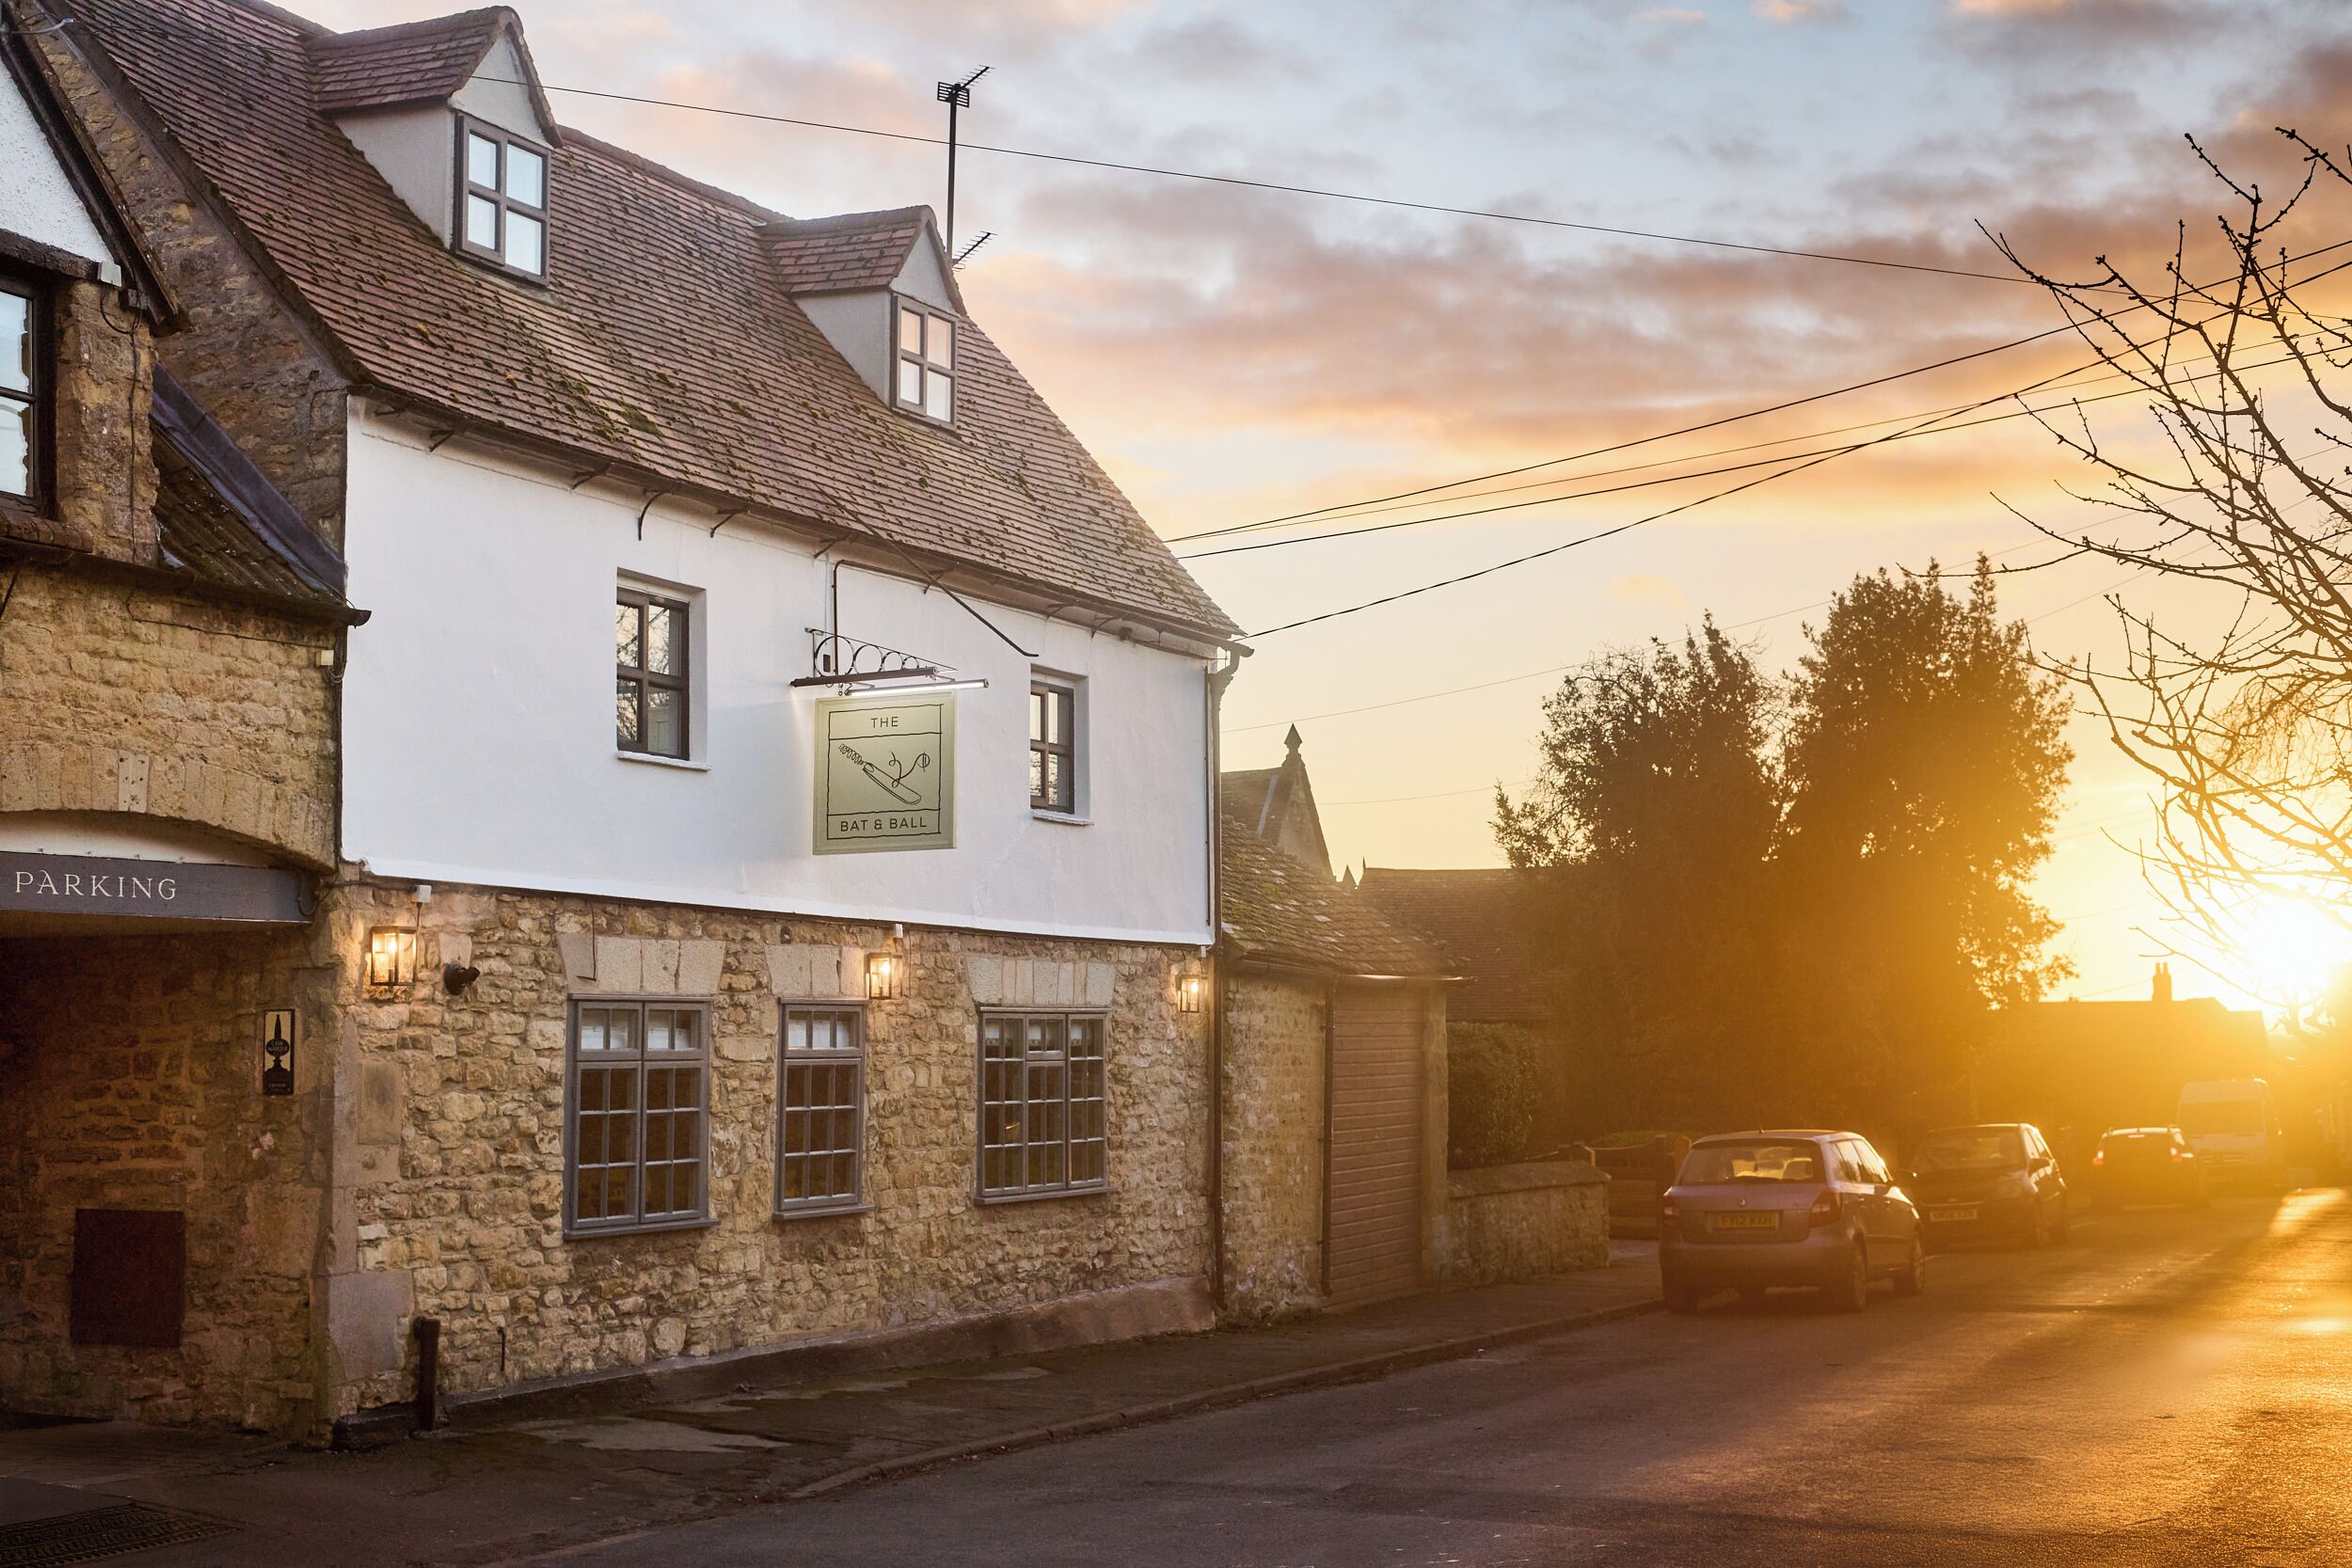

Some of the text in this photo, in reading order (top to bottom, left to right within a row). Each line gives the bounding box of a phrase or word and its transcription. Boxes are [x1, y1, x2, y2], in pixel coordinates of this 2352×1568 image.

[870, 716, 899, 728] THE
[840, 816, 928, 832] BAT & BALL
[15, 869, 177, 900] PARKING
